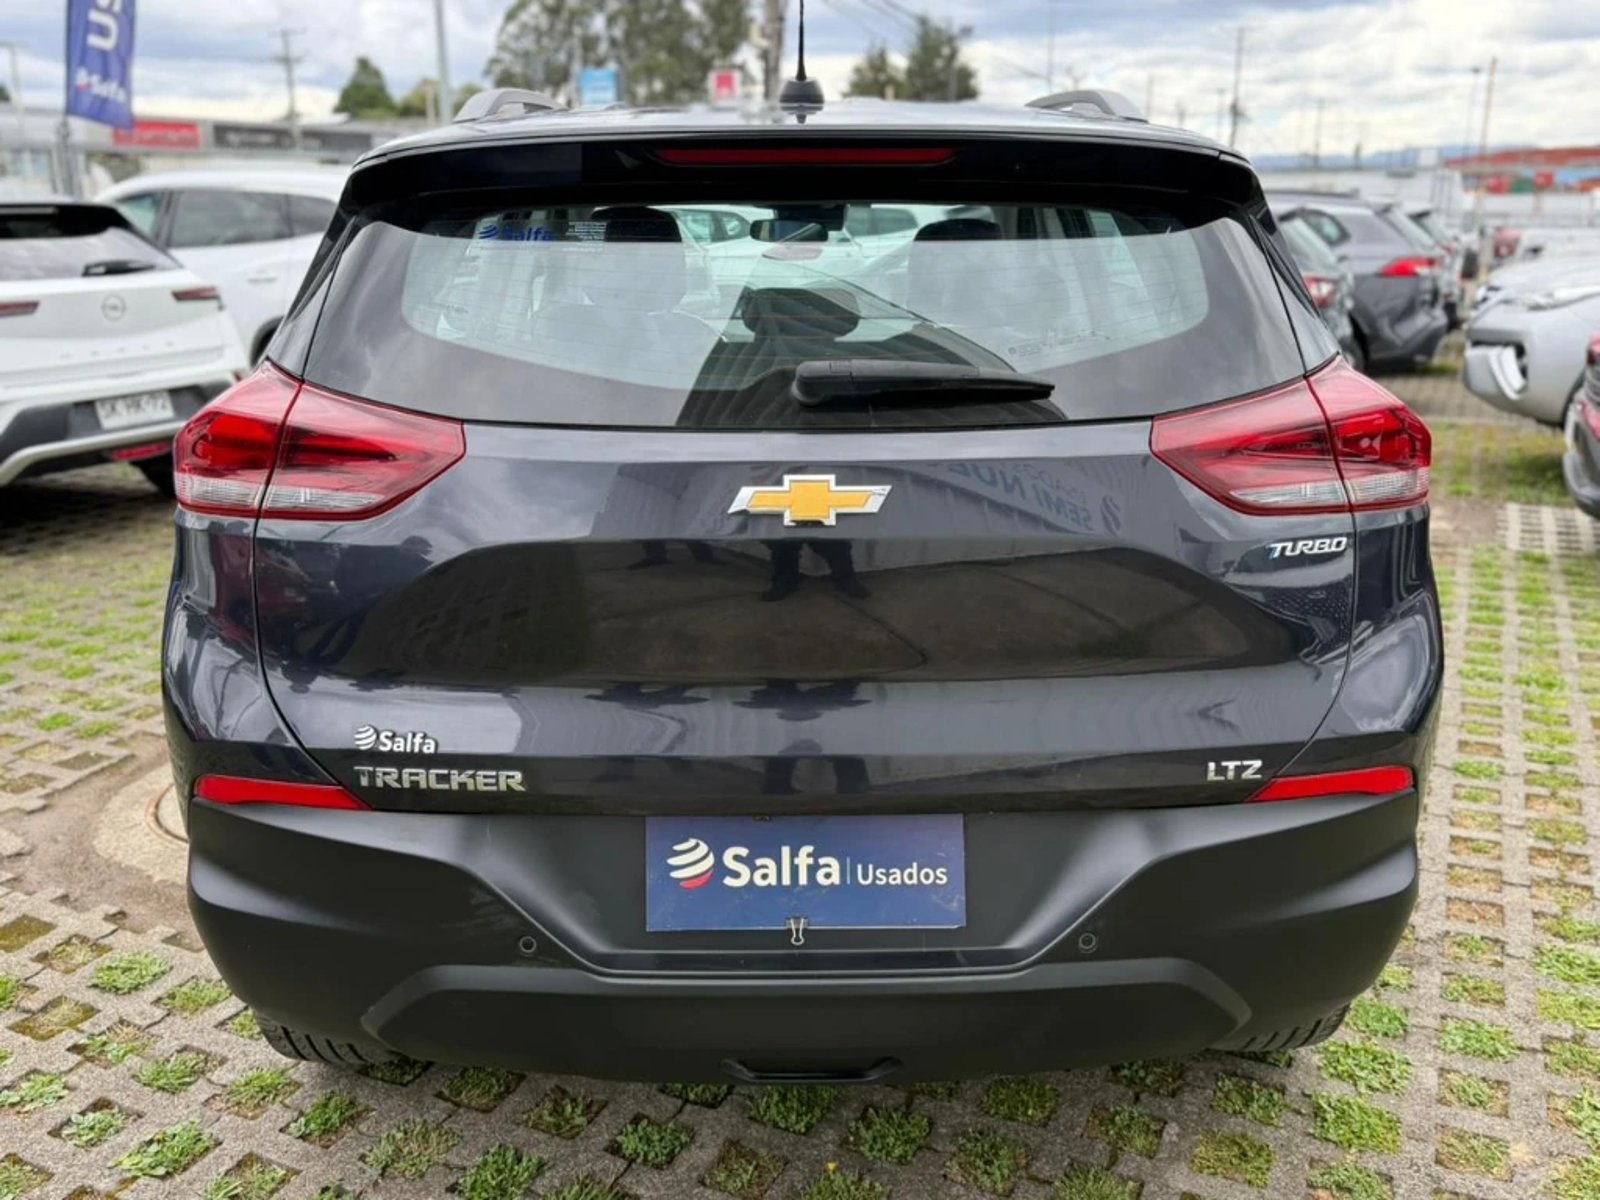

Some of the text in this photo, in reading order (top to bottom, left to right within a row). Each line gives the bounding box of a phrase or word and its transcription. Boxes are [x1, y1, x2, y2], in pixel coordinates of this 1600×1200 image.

[1265, 536, 1348, 560] TURBO
[378, 730, 437, 755] Salfa
[353, 765, 527, 793] TRACKER
[1206, 759, 1263, 781] LTZ
[722, 845, 948, 888] Salfa Usados
